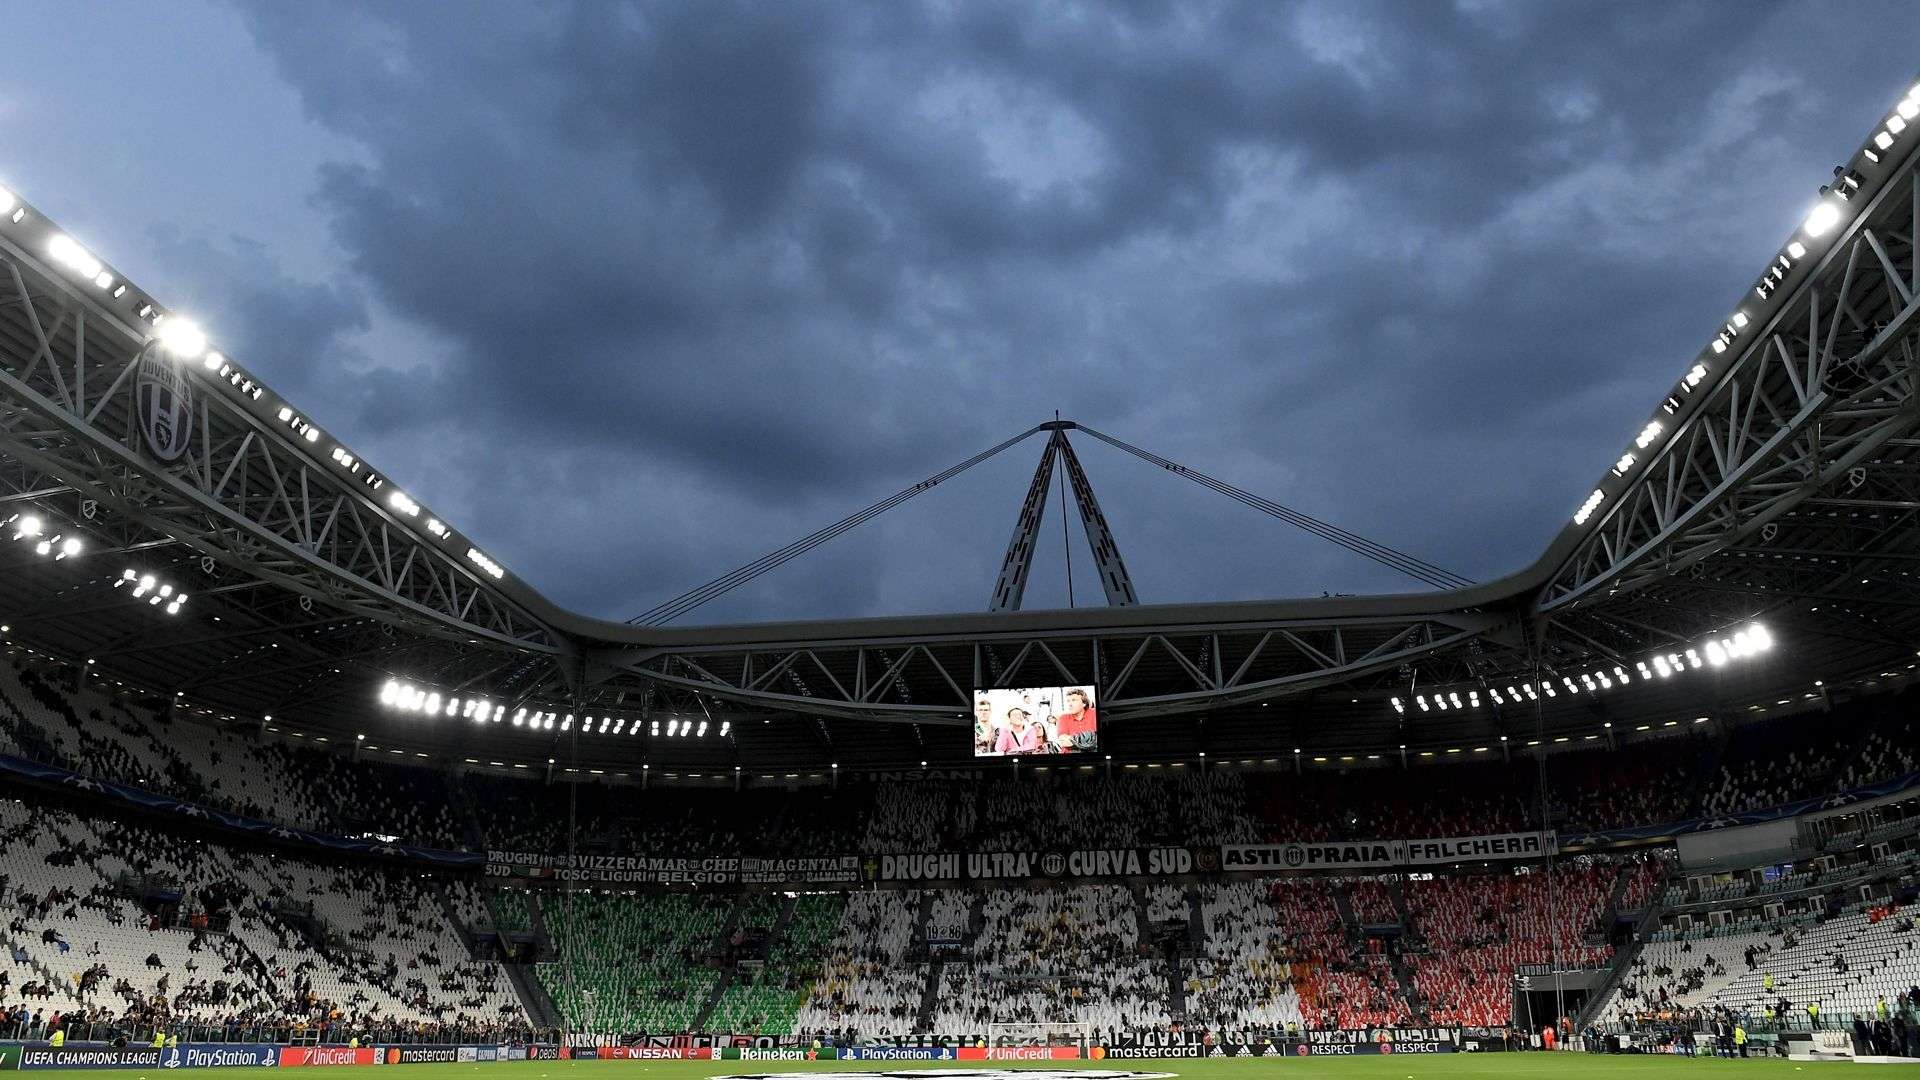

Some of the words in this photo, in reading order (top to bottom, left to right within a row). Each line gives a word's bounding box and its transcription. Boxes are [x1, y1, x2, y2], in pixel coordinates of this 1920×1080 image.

[143, 358, 191, 402] JUVENUS
[1409, 836, 1540, 859] FALCHERA
[487, 850, 538, 865] DRUGHI
[1225, 849, 1280, 865] ASTI
[1308, 845, 1390, 863] PRAIA
[568, 855, 647, 870] SVIZZERA
[760, 859, 840, 871] MAGENTA
[882, 855, 960, 880] DRUGHI
[1069, 849, 1141, 876] CURVA
[1149, 848, 1191, 875] SUD
[485, 864, 511, 877] SUD
[658, 871, 727, 883] BELGIO
[539, 1047, 558, 1060] pepsi
[628, 1049, 682, 1059] NISSAN
[739, 1048, 804, 1060] Heineken
[861, 1048, 932, 1060] PlayStation
[997, 1048, 1053, 1060] UniCredit
[1109, 1044, 1198, 1058] mastercard
[1311, 1044, 1356, 1055] RESPECT
[1395, 1042, 1439, 1053] RESPECT
[24, 1052, 54, 1065] UEFA
[56, 1052, 118, 1065] CHAMPIONS
[120, 1052, 158, 1065] LEAGUE
[186, 1049, 257, 1067] PlayStation
[313, 1049, 356, 1065] UniCredit
[402, 1047, 455, 1062] mastercard
